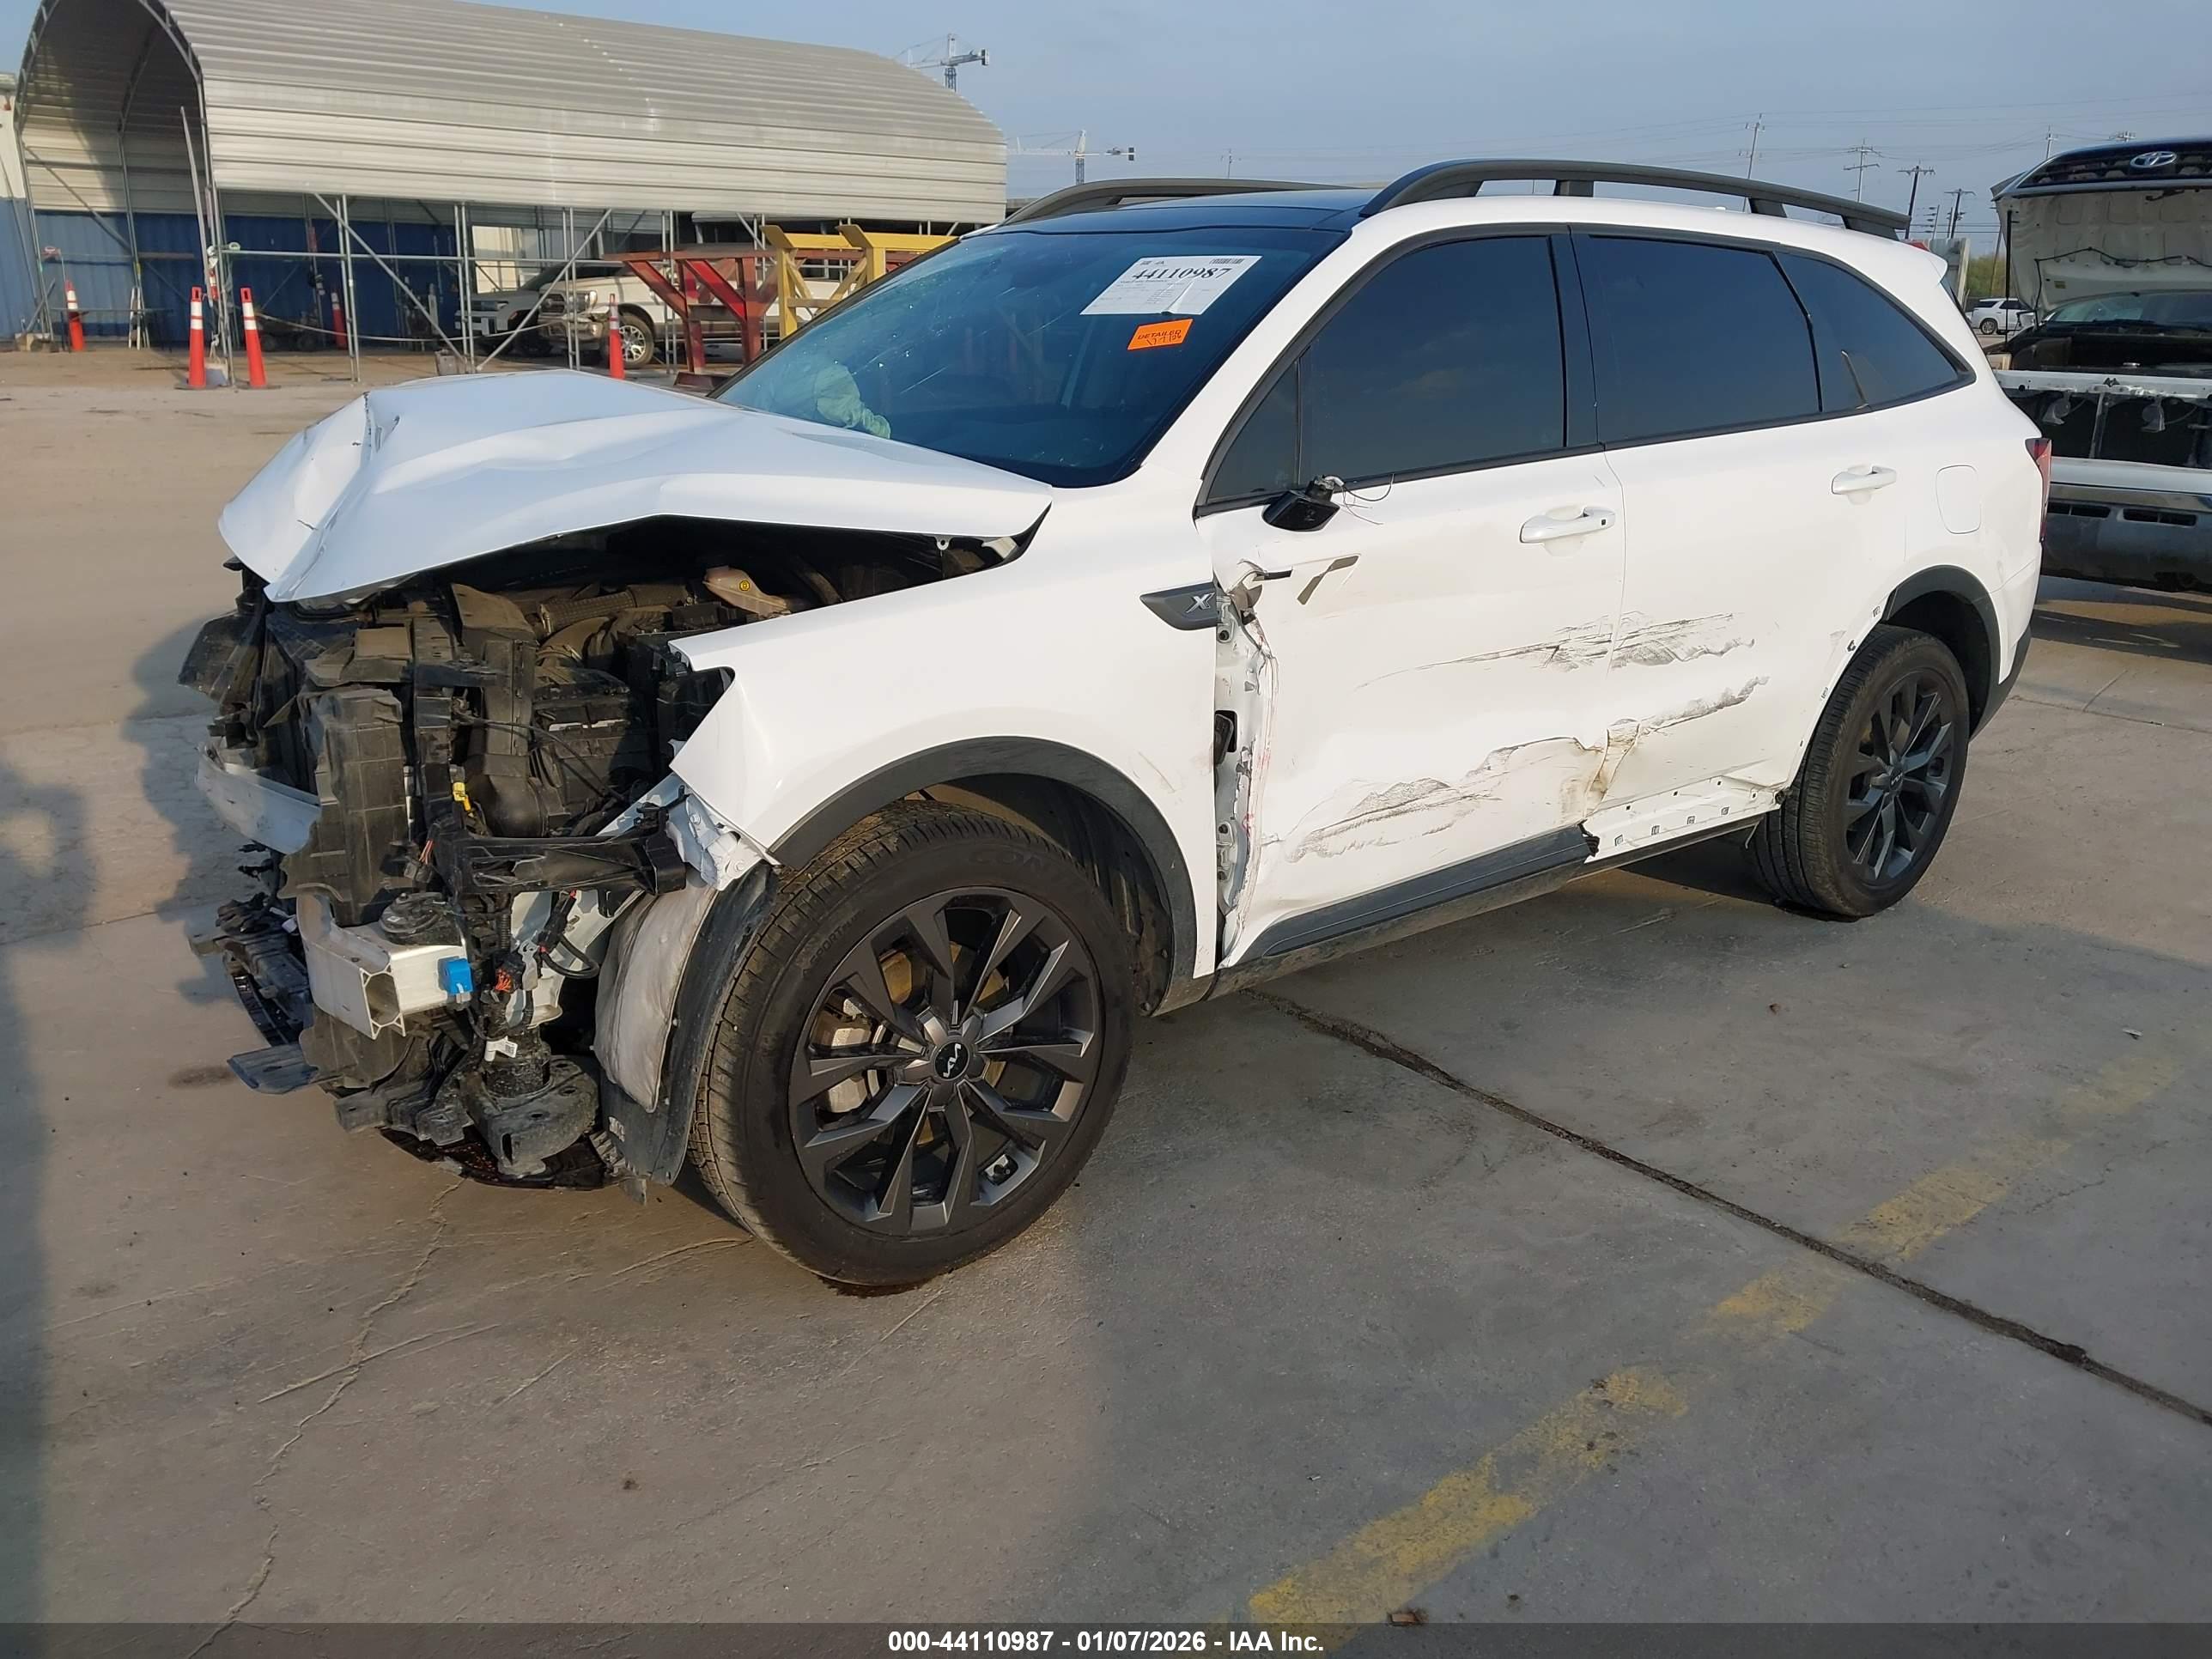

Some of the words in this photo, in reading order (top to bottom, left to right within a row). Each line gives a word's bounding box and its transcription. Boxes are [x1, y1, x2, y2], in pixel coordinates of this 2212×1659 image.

[1132, 266, 1233, 280] 44110987
[1137, 329, 1182, 340] DETAILED
[1185, 592, 1216, 614] X
